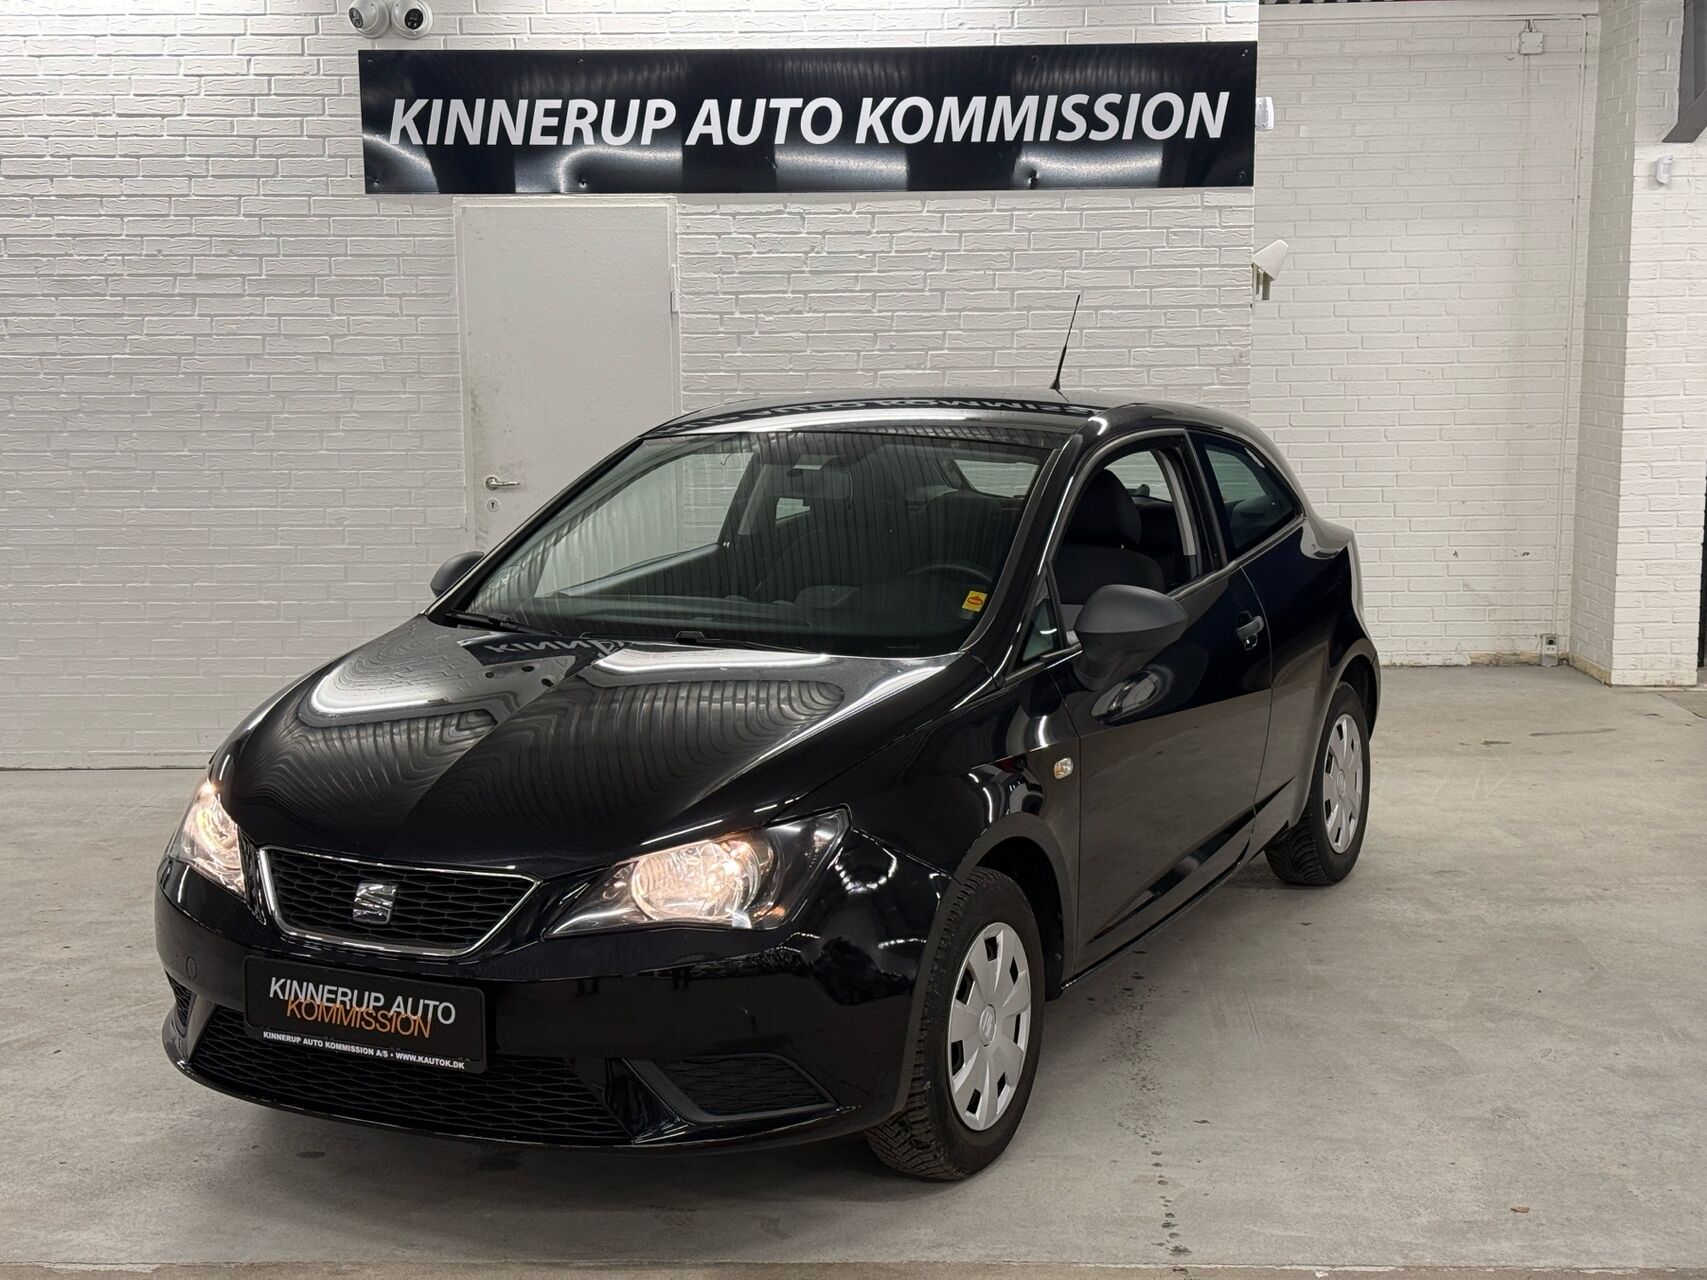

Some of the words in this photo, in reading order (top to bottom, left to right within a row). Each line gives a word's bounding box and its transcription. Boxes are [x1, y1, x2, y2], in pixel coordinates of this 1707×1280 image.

[389, 98, 677, 147] KINNERUP
[684, 96, 844, 146] AUTO
[855, 91, 1230, 145] KOMMISSION
[269, 977, 384, 1012] KINNERUP
[389, 995, 456, 1025] AUTO
[286, 996, 432, 1038] KOMMISSION
[263, 1031, 301, 1044] KINNERUP
[303, 1038, 324, 1048] AUTO
[325, 1041, 374, 1056] KOMMISSION
[376, 1049, 388, 1058] A/S
[395, 1052, 465, 1070] WWW.KAUTOK.DK
